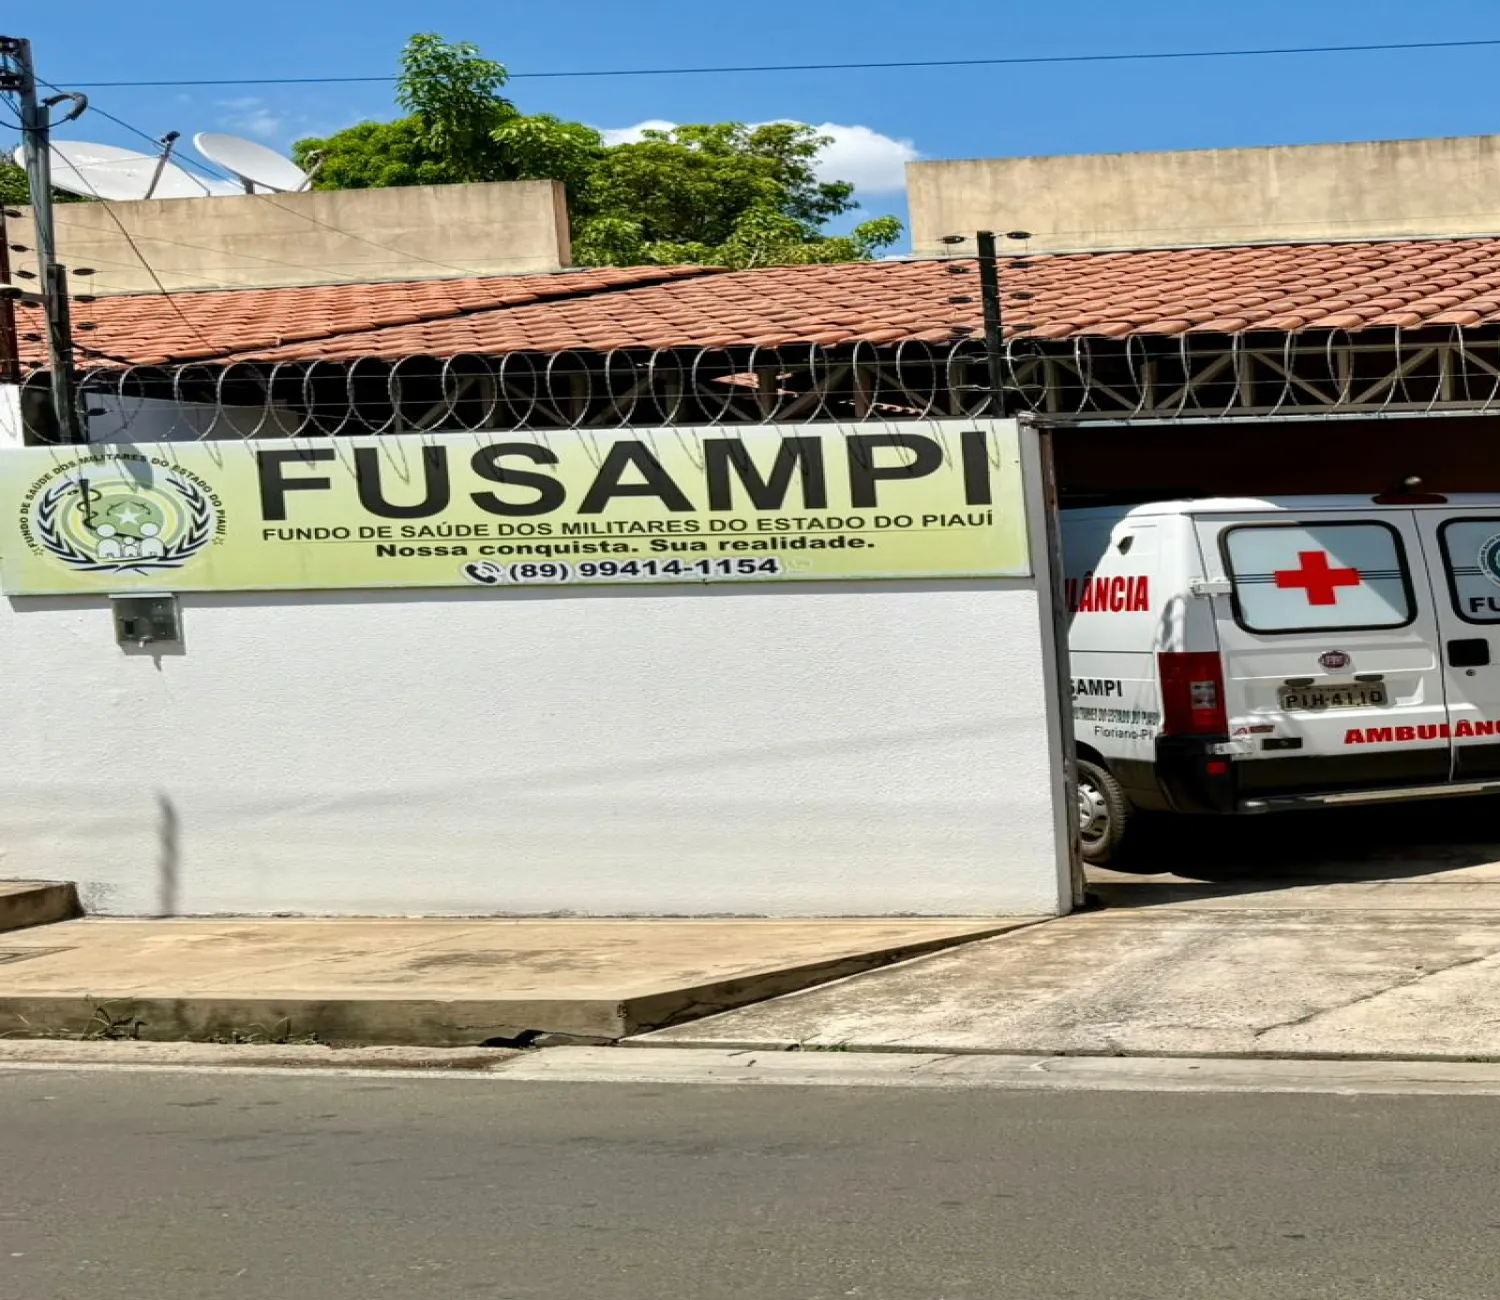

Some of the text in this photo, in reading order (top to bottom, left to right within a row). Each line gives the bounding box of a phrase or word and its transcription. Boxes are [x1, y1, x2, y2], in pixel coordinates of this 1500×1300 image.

[52, 460, 77, 475] DOS
[78, 453, 147, 465] MILITARES
[151, 457, 170, 468] DO
[171, 463, 213, 494] ESTADO
[256, 431, 993, 521] FUSAMPI
[20, 501, 31, 515] DE
[209, 493, 223, 509] DO
[19, 515, 36, 548] FUNDO
[262, 509, 993, 541] FUNDO DE SAÚDE DOS MILITARES DO ESTADO DO PIAUÍ
[376, 535, 875, 558] Nossa conquista. Sua realidade.
[509, 557, 779, 582] (89) 99414-1154
